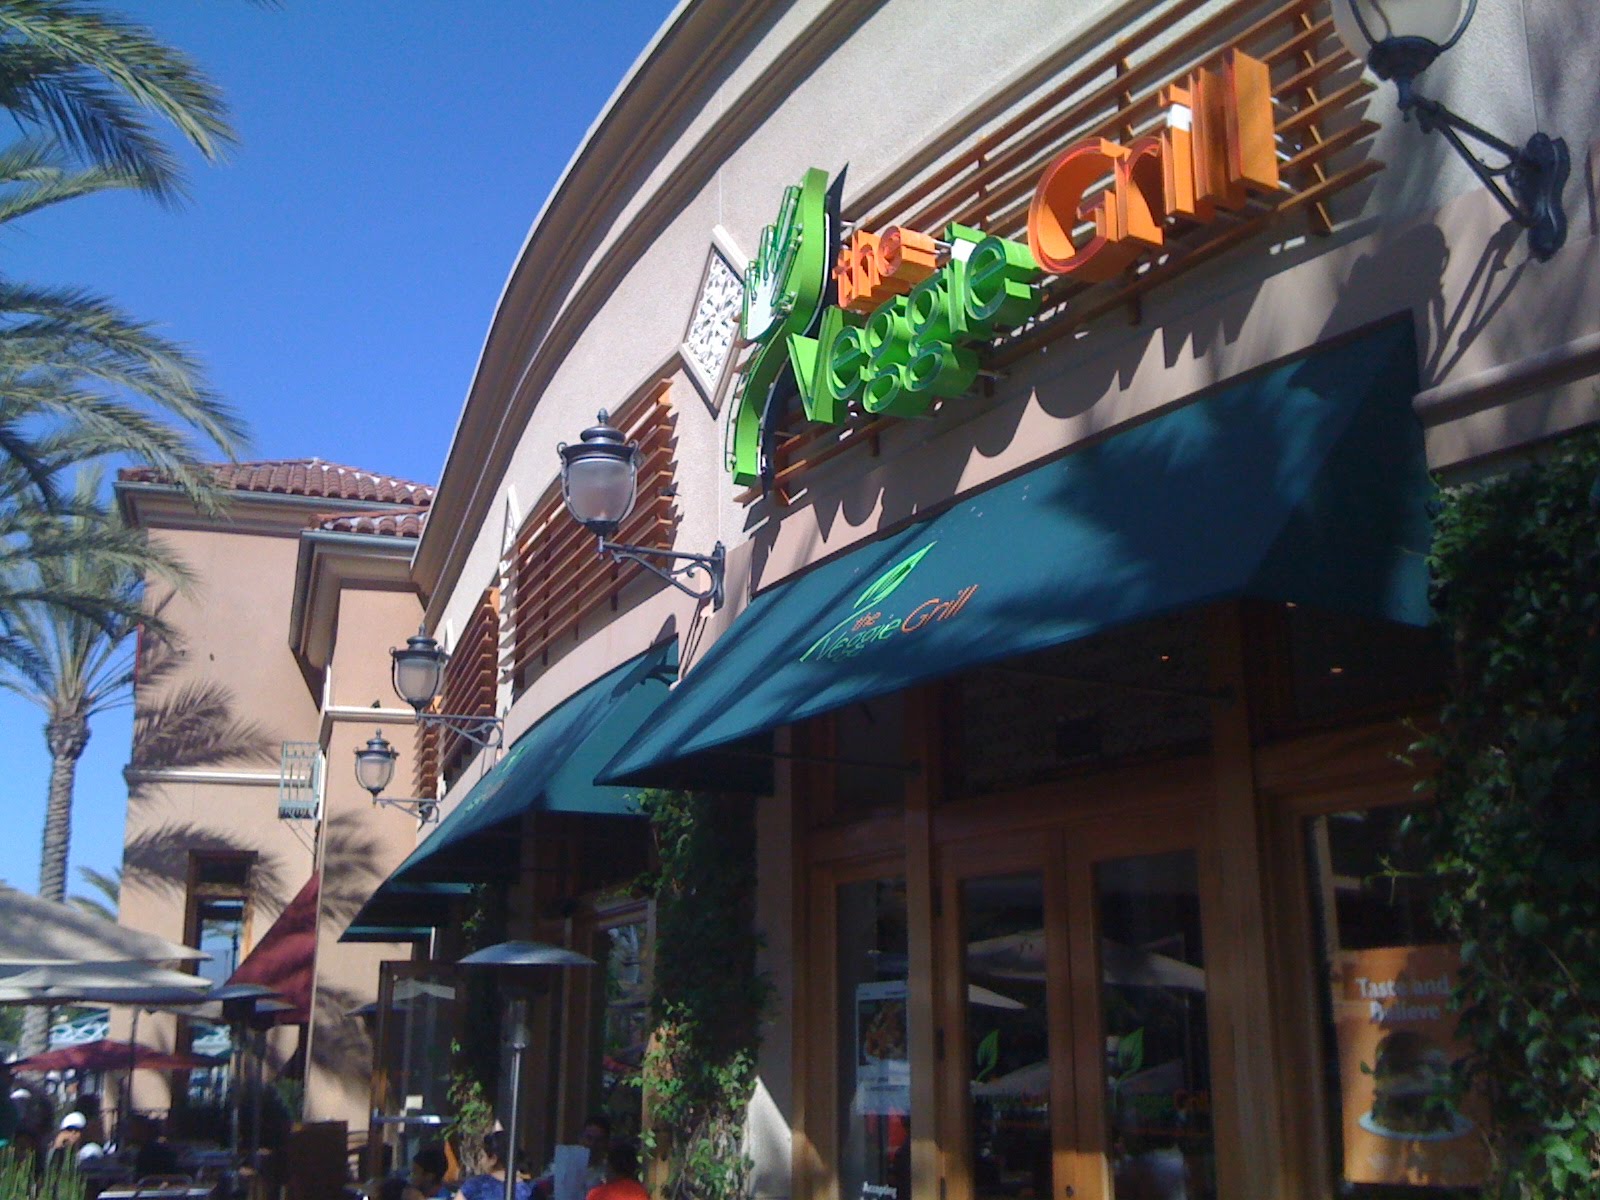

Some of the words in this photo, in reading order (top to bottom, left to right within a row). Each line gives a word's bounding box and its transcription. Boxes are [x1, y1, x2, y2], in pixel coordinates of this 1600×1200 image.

[787, 221, 1043, 423] Veggie
[1028, 48, 1279, 277] Grill
[833, 225, 936, 312] the
[816, 618, 902, 663] Veggie
[901, 583, 979, 634] Grill
[852, 611, 882, 631] the
